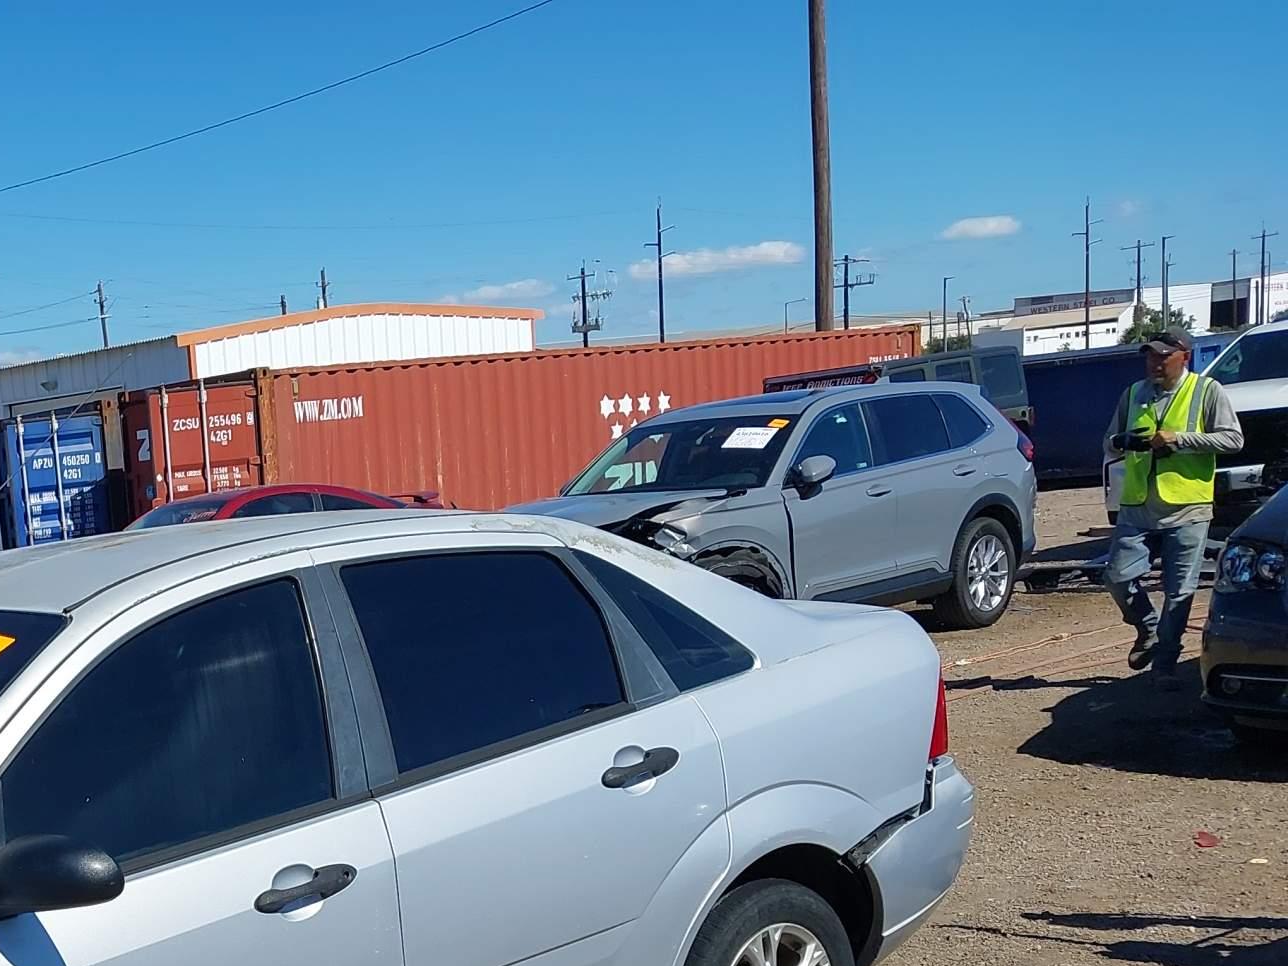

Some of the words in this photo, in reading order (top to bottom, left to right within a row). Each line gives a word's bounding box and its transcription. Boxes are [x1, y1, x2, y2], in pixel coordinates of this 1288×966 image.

[1030, 303, 1070, 315] WESTERN
[1073, 301, 1098, 310] STEL
[1102, 297, 1115, 305] CO
[172, 417, 200, 432] ZCSU
[208, 413, 242, 428] 255496
[210, 429, 232, 443] 42G1
[32, 457, 54, 470] APZU
[62, 454, 90, 466] 450250
[63, 468, 82, 480] 42G1
